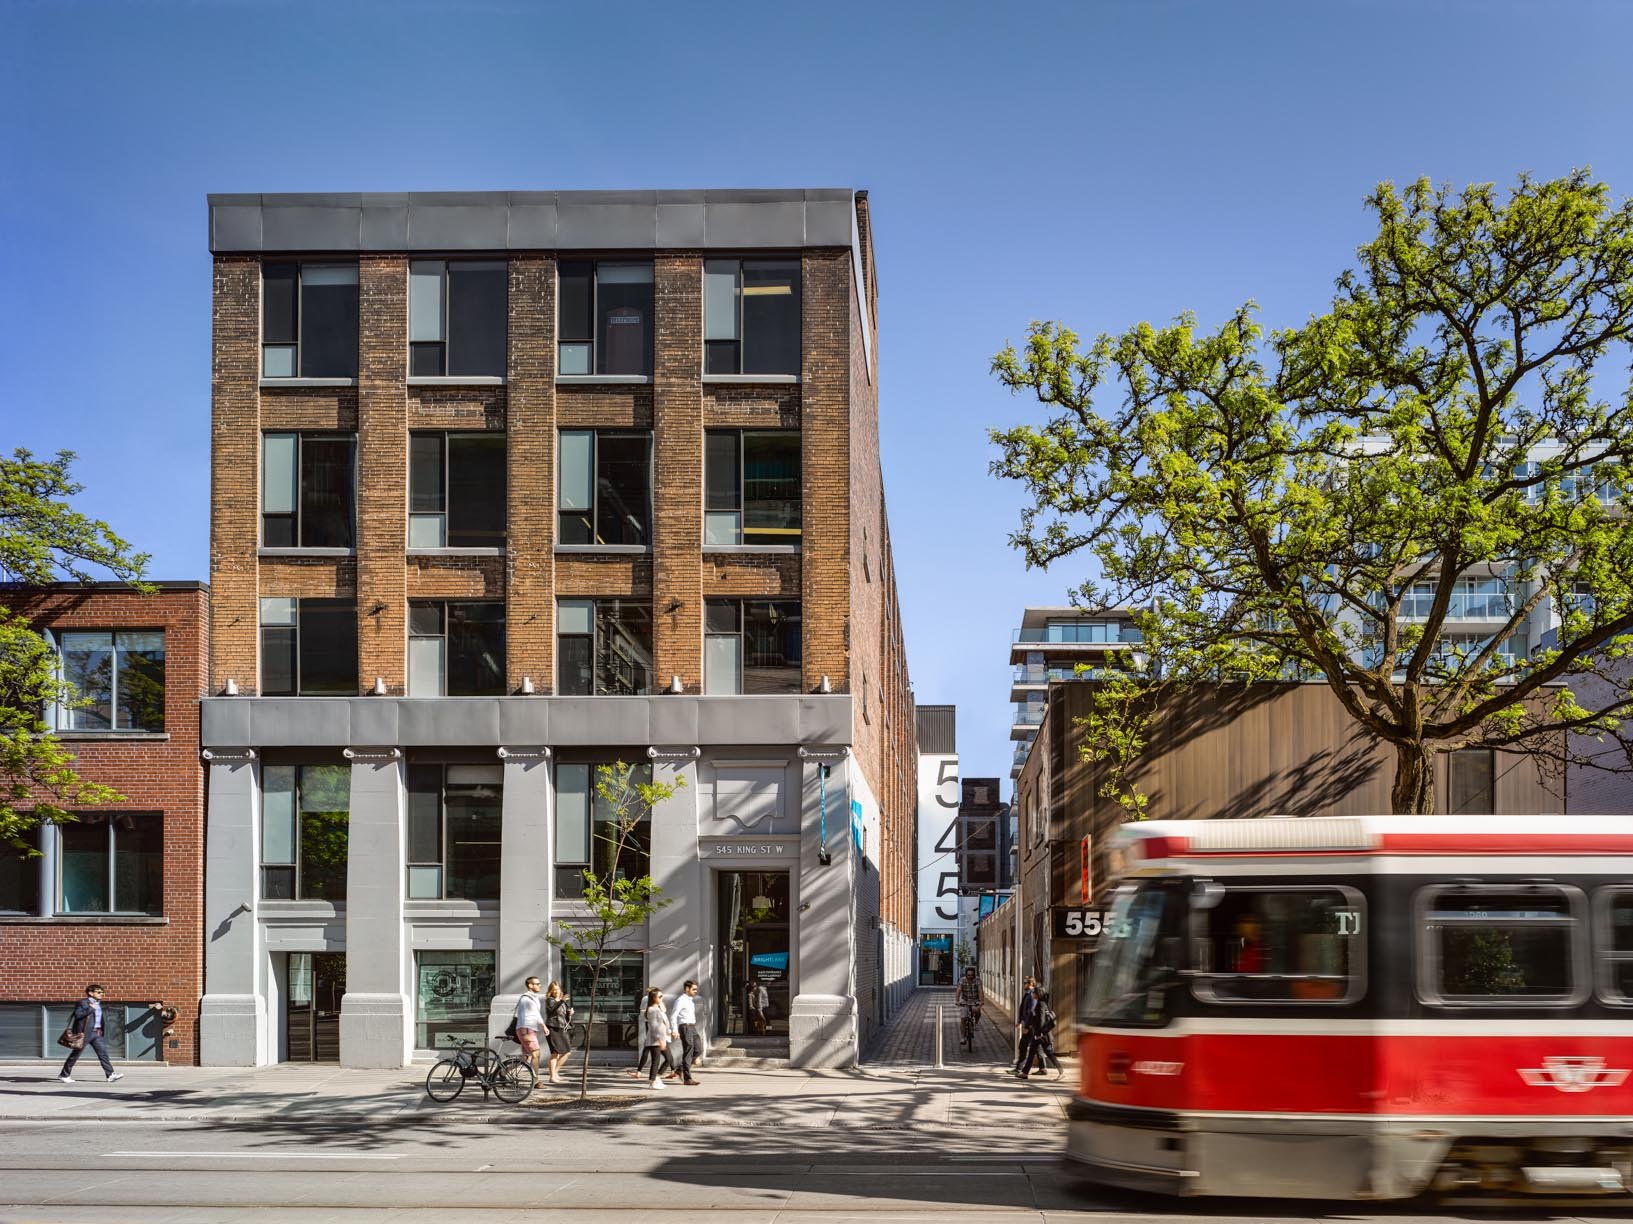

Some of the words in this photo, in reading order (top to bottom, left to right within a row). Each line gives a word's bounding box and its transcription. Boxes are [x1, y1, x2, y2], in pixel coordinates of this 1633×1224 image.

[716, 845, 732, 854] 545
[737, 845, 757, 854] KING
[761, 845, 771, 854] ST
[776, 845, 784, 854] W
[934, 760, 959, 920] 545
